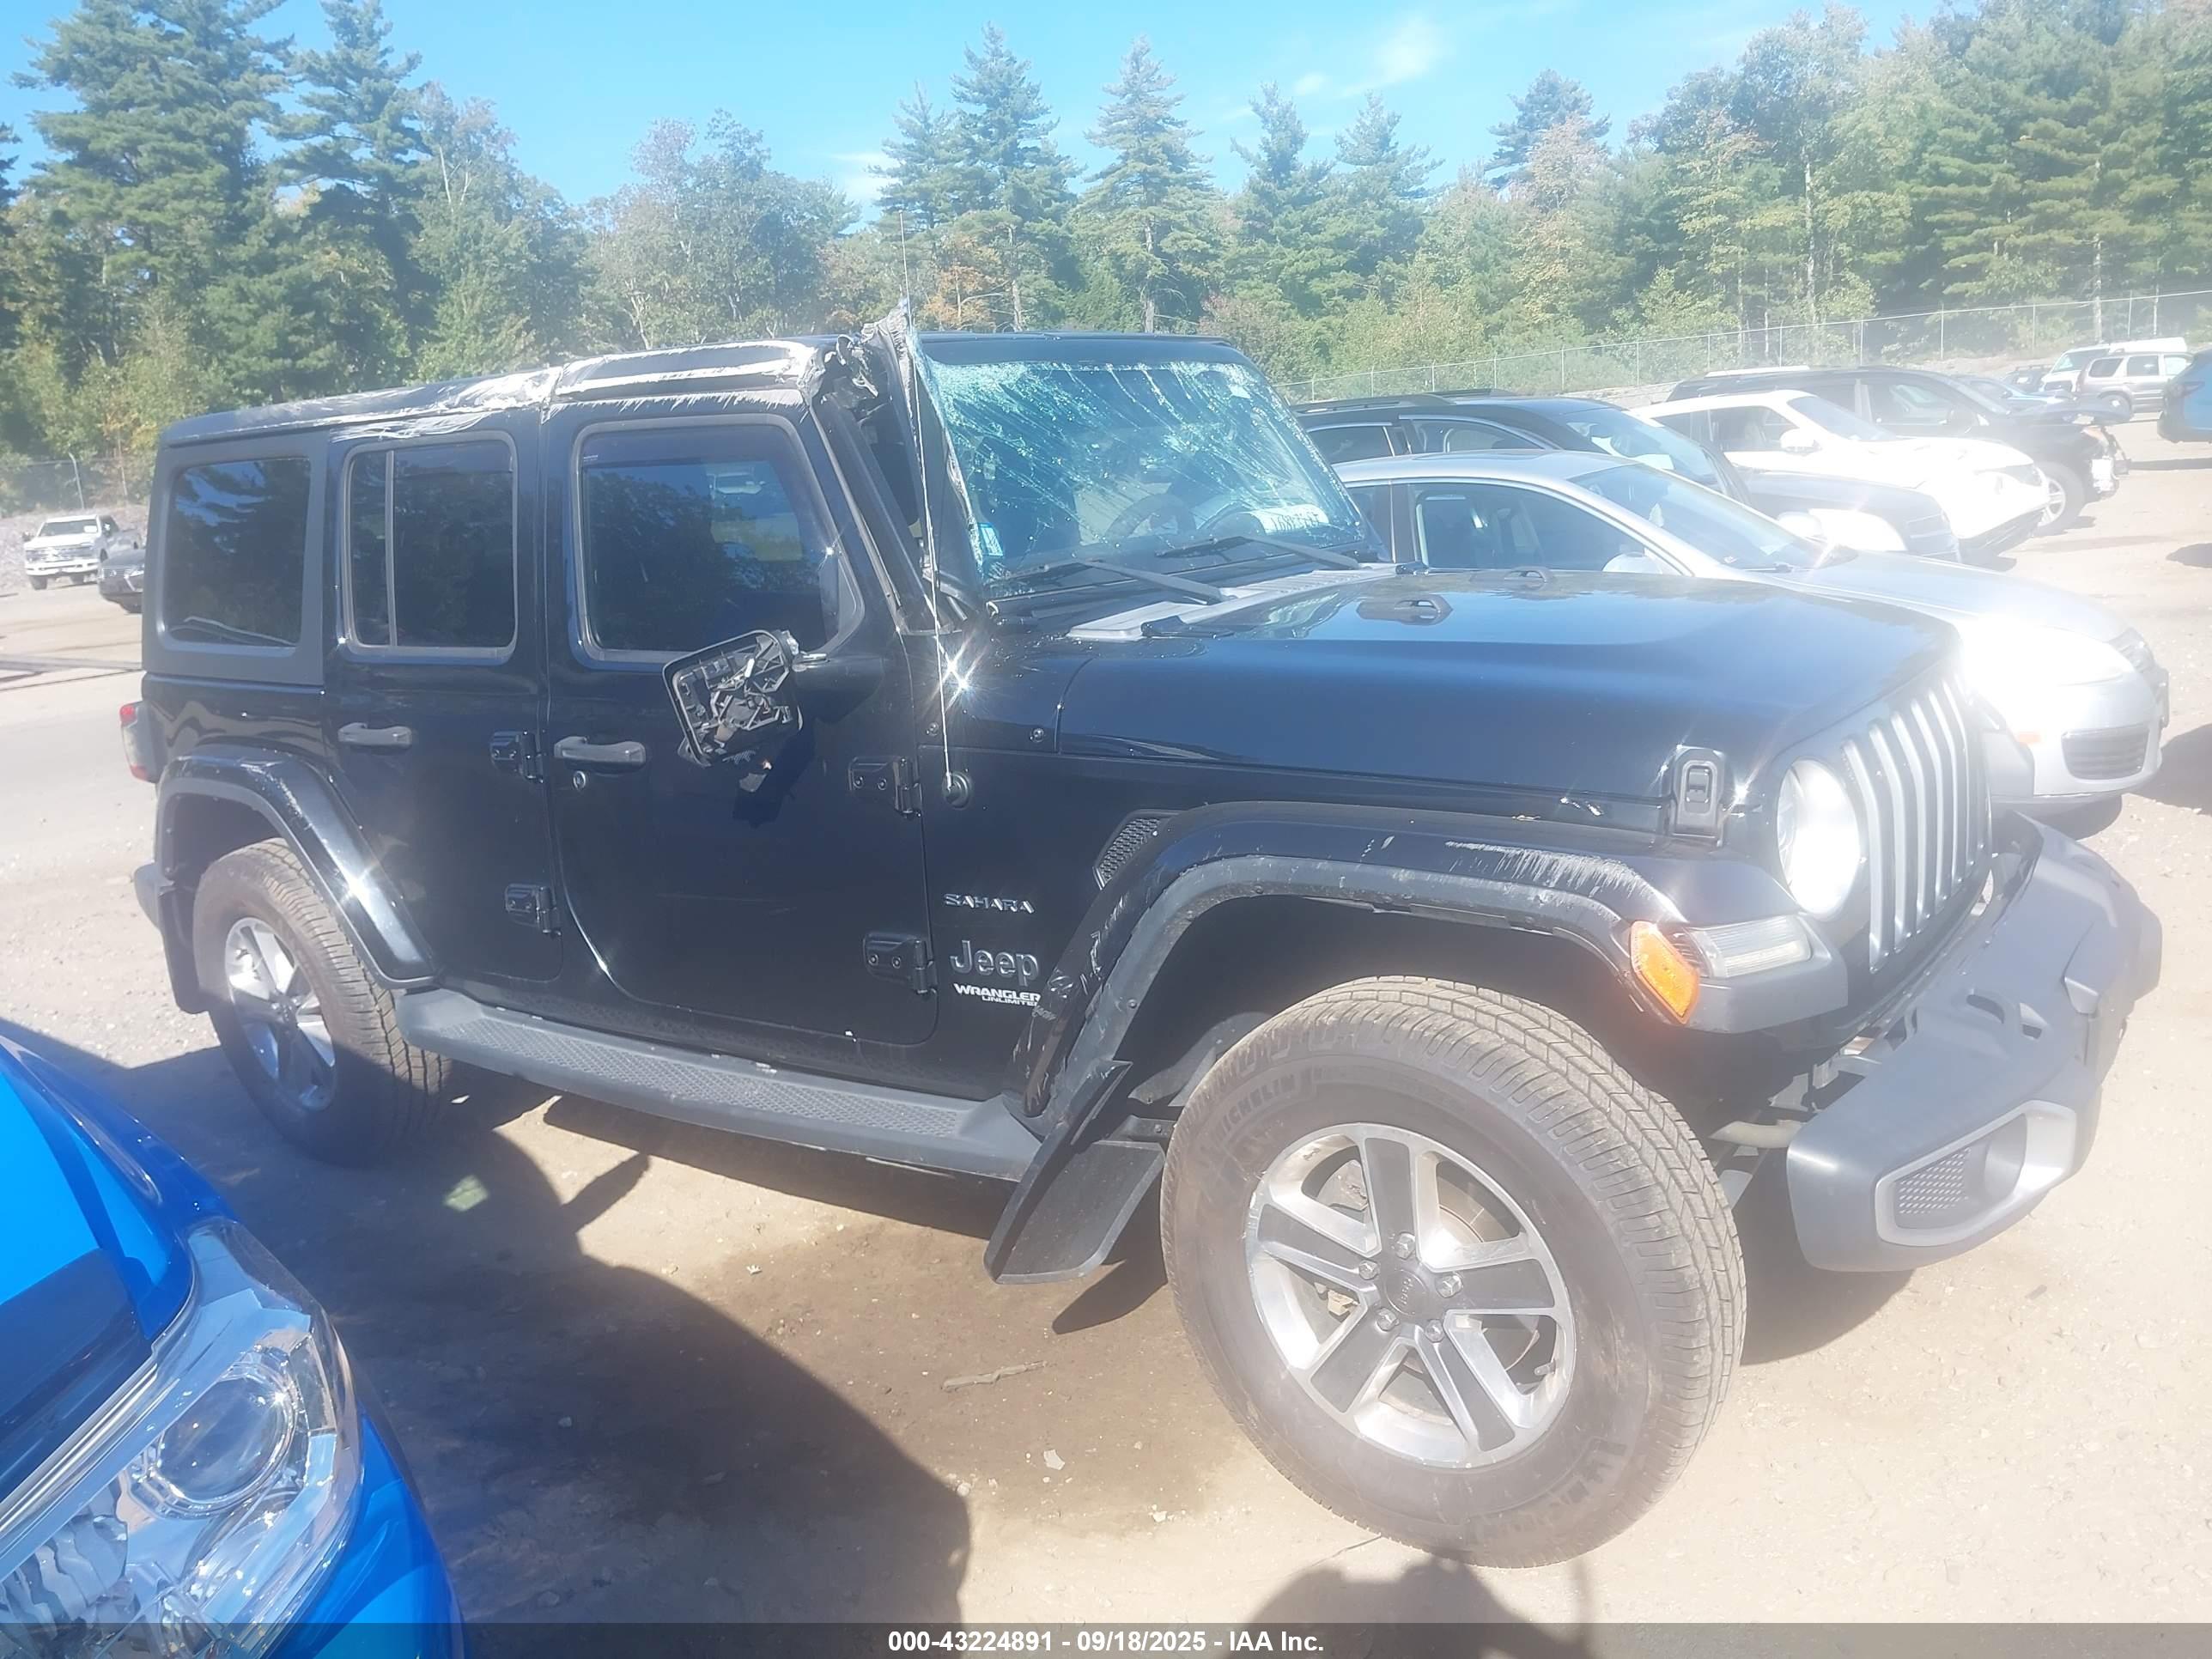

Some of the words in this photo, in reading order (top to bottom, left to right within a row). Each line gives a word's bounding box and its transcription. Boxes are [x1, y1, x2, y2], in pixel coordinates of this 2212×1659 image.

[944, 893, 1035, 914] SAHARA
[950, 939, 1039, 987] Jeep
[953, 983, 1041, 1001] WRANGLER
